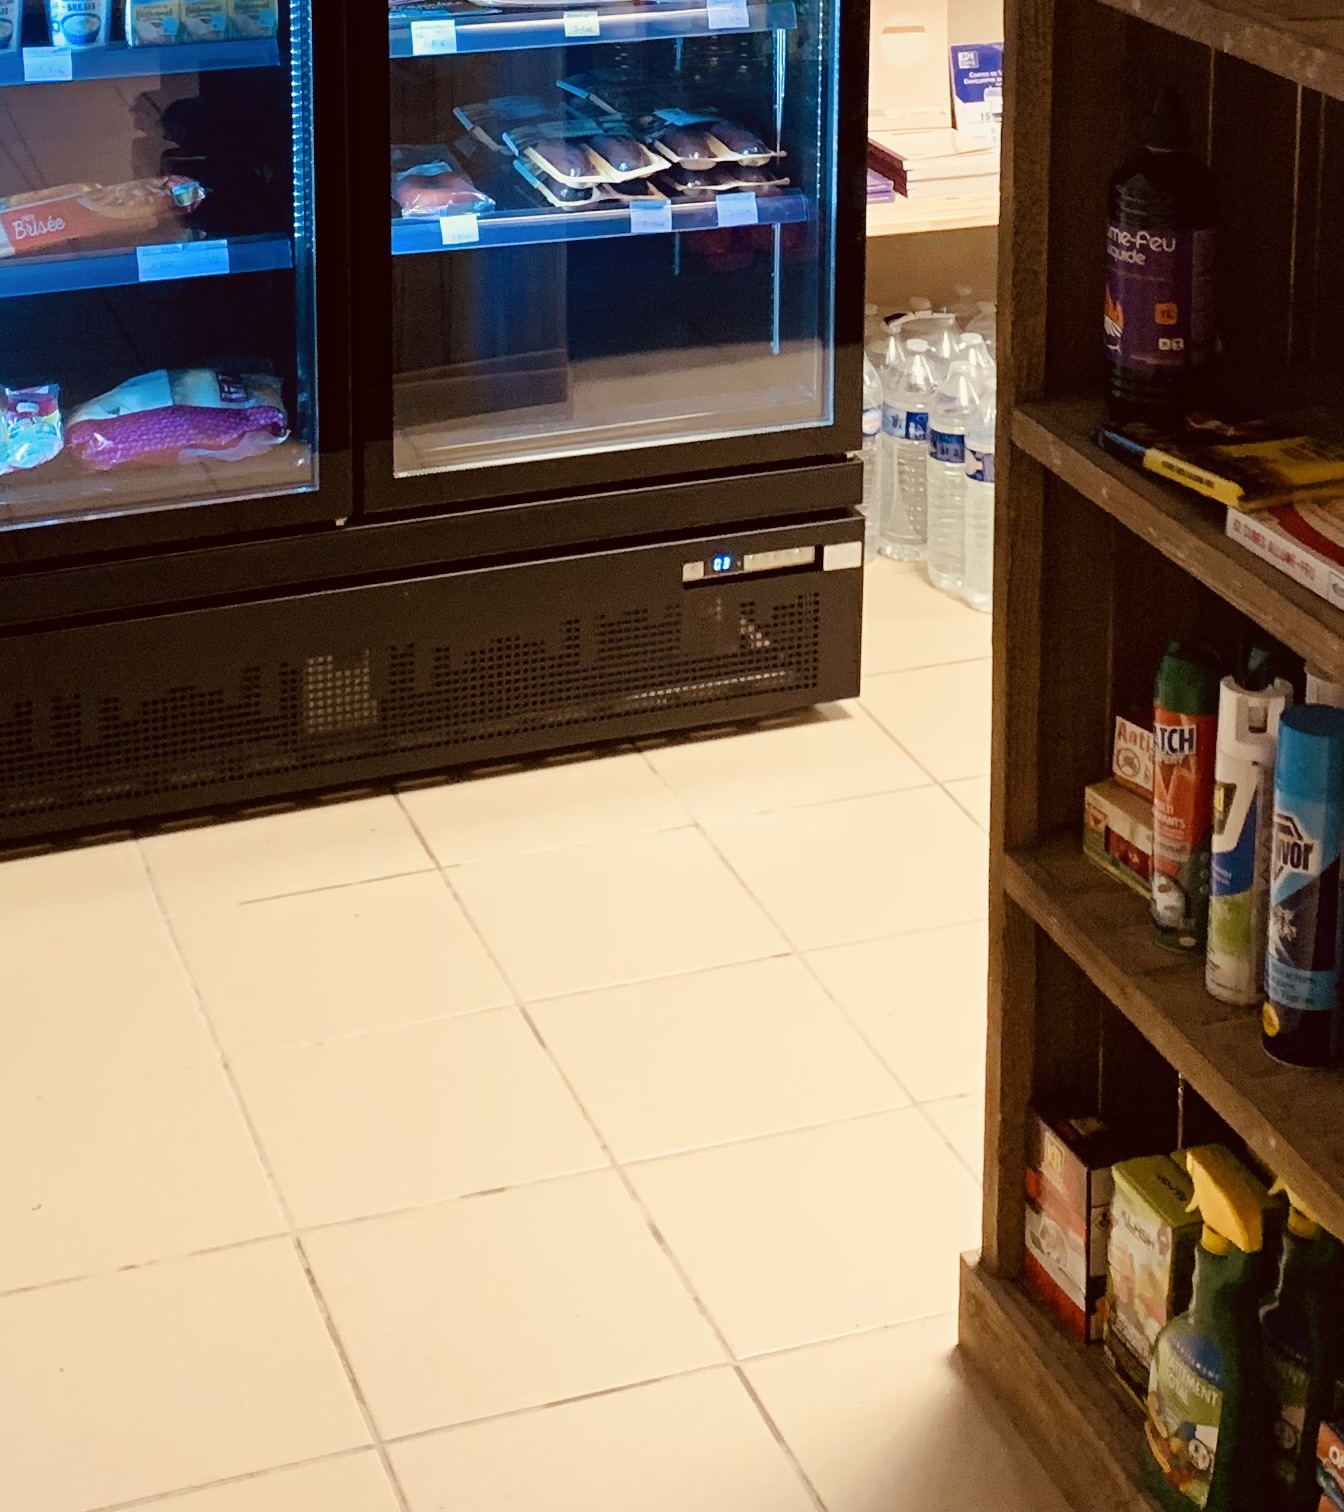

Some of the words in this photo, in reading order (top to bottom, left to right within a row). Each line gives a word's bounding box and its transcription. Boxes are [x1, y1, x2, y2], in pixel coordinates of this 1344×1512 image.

[979, 112, 991, 121] 15
[11, 215, 65, 240] Brisée
[1156, 726, 1196, 754] TCH
